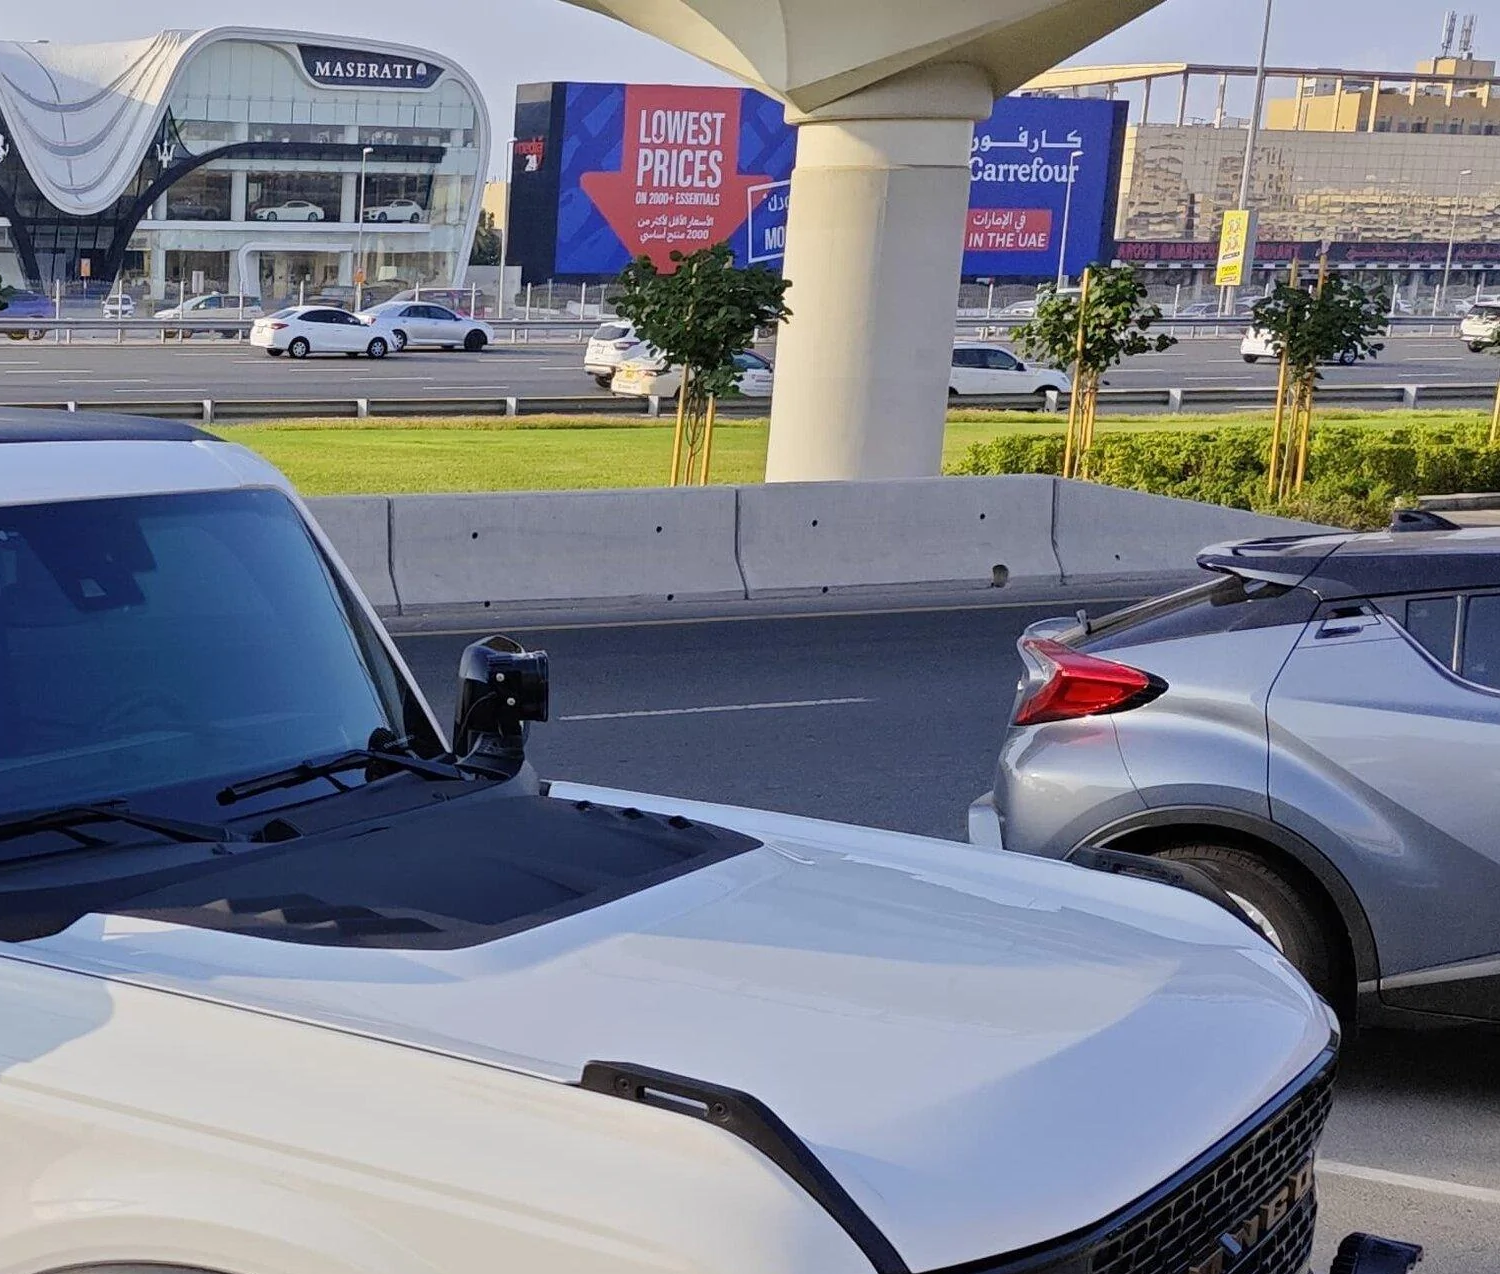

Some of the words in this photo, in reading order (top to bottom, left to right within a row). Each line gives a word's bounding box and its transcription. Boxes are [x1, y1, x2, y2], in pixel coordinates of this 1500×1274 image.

[314, 60, 414, 80] MASERATI
[639, 109, 727, 146] LOWEST
[970, 126, 1083, 154] كارفور
[636, 147, 723, 189] PRICES
[969, 156, 1080, 183] Carrefour
[635, 191, 647, 205] ON
[648, 191, 674, 205] 2000+
[675, 192, 720, 206] ESSENTIALS
[972, 211, 1013, 230] الإمارات
[1014, 211, 1027, 233] في
[686, 229, 709, 240] 2000
[764, 226, 786, 251] MO
[967, 233, 984, 248] IN
[988, 233, 1015, 248] THE
[1018, 233, 1048, 248] UAE
